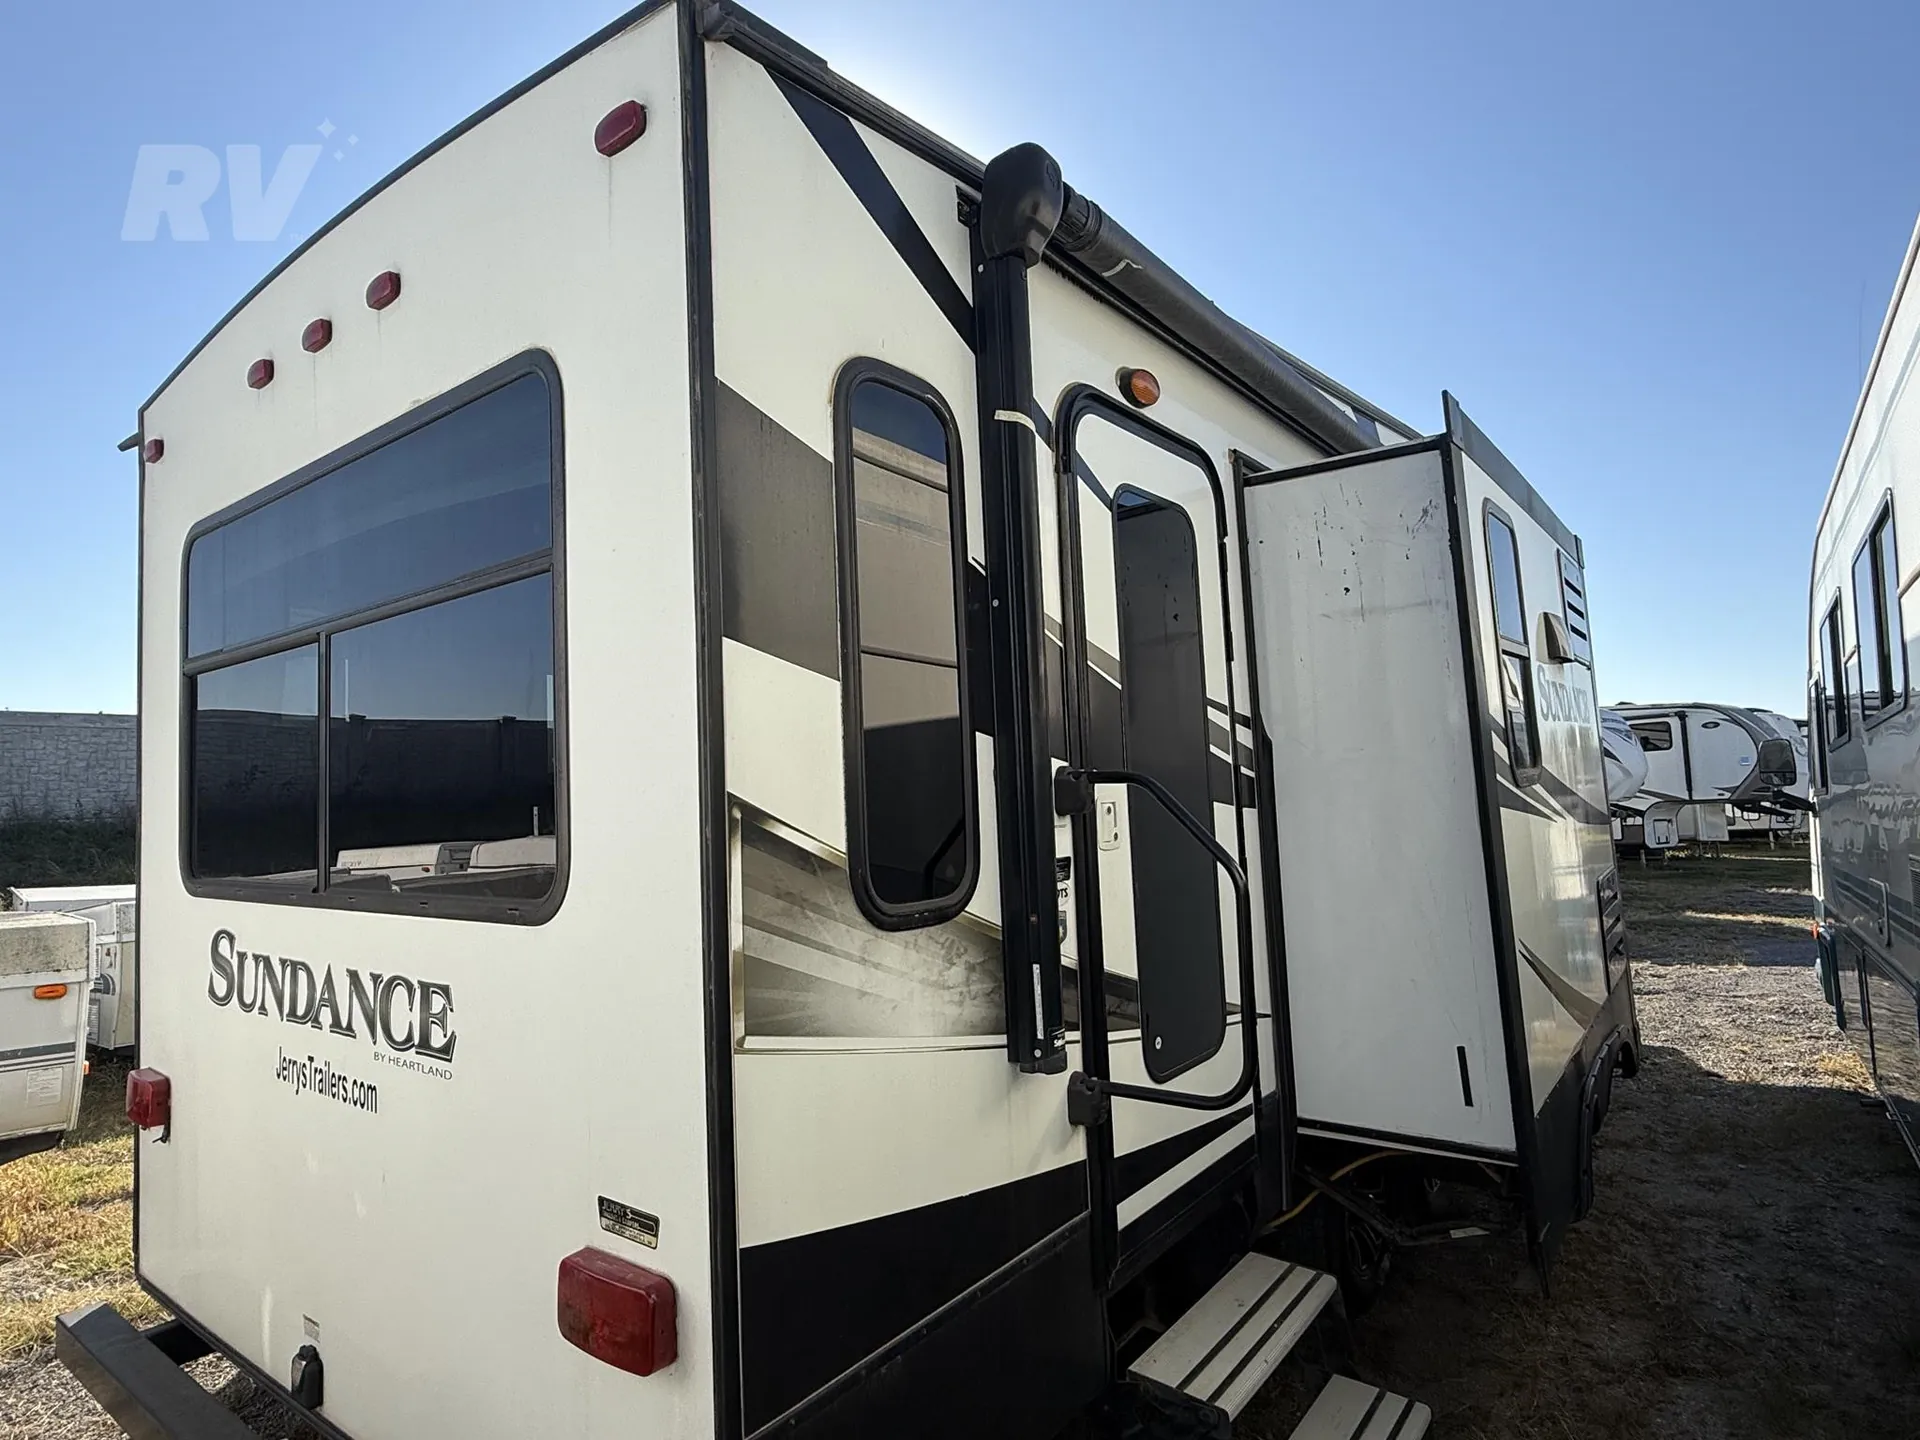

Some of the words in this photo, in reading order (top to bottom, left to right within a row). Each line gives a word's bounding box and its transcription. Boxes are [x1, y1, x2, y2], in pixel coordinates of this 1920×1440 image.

[207, 928, 457, 1064] SUNDANCE
[275, 1046, 378, 1114] JerrysTrailers.com
[373, 1051, 386, 1063] BY
[388, 1056, 453, 1081] HEARTLAND
